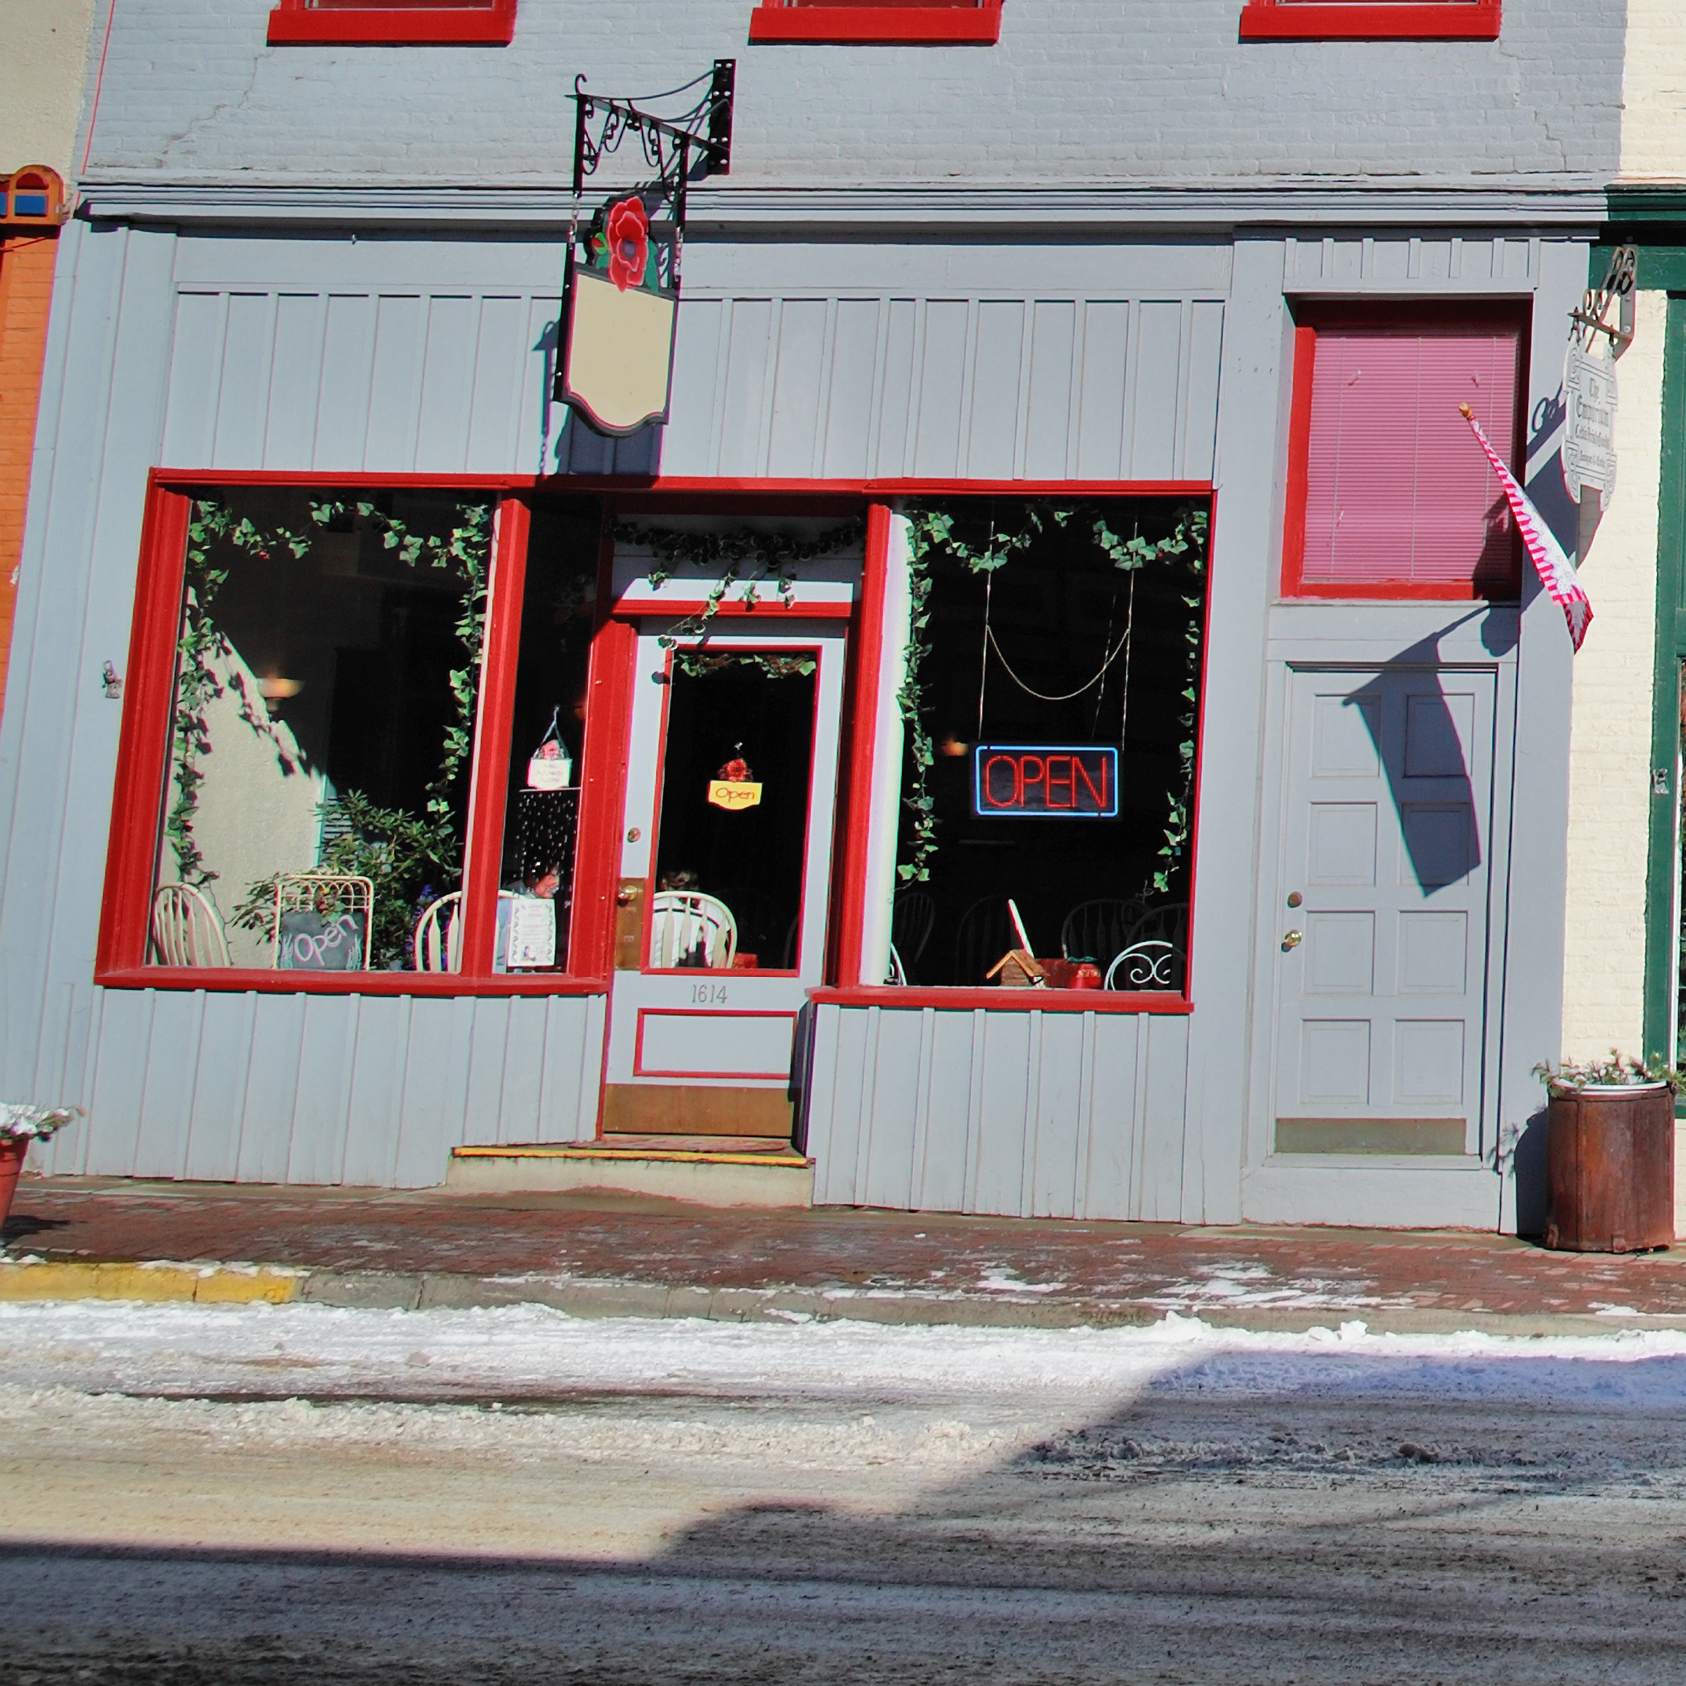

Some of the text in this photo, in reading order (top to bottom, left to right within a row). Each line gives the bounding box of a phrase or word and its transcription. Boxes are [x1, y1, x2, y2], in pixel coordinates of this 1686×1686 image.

[715, 787, 755, 803] Open
[984, 755, 1107, 808] OPEN
[293, 914, 358, 966] Open
[692, 984, 728, 1004] 1614
